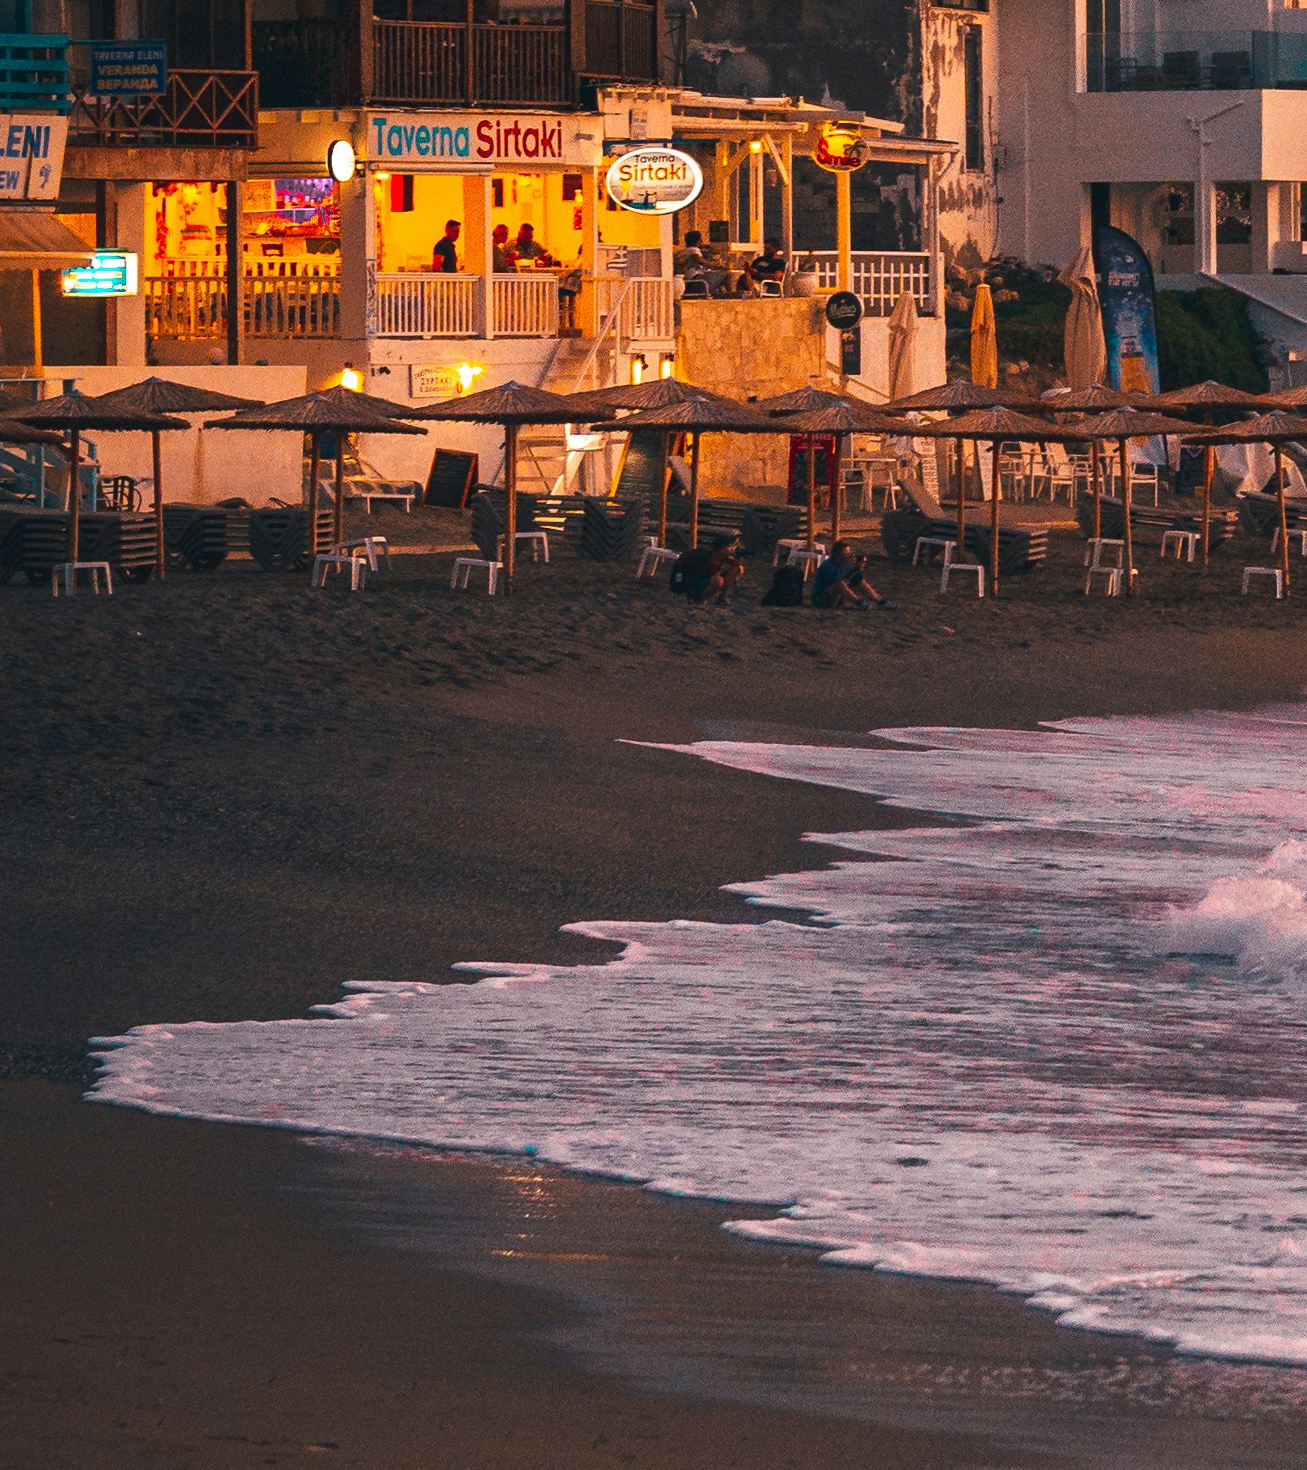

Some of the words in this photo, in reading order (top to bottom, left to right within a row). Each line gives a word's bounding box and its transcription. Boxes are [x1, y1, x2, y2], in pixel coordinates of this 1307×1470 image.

[97, 64, 159, 75] VERANDA
[372, 117, 470, 157] Taverna
[476, 119, 563, 159] Sirtaki
[634, 154, 675, 164] Taverna
[619, 163, 687, 181] Sirtaki
